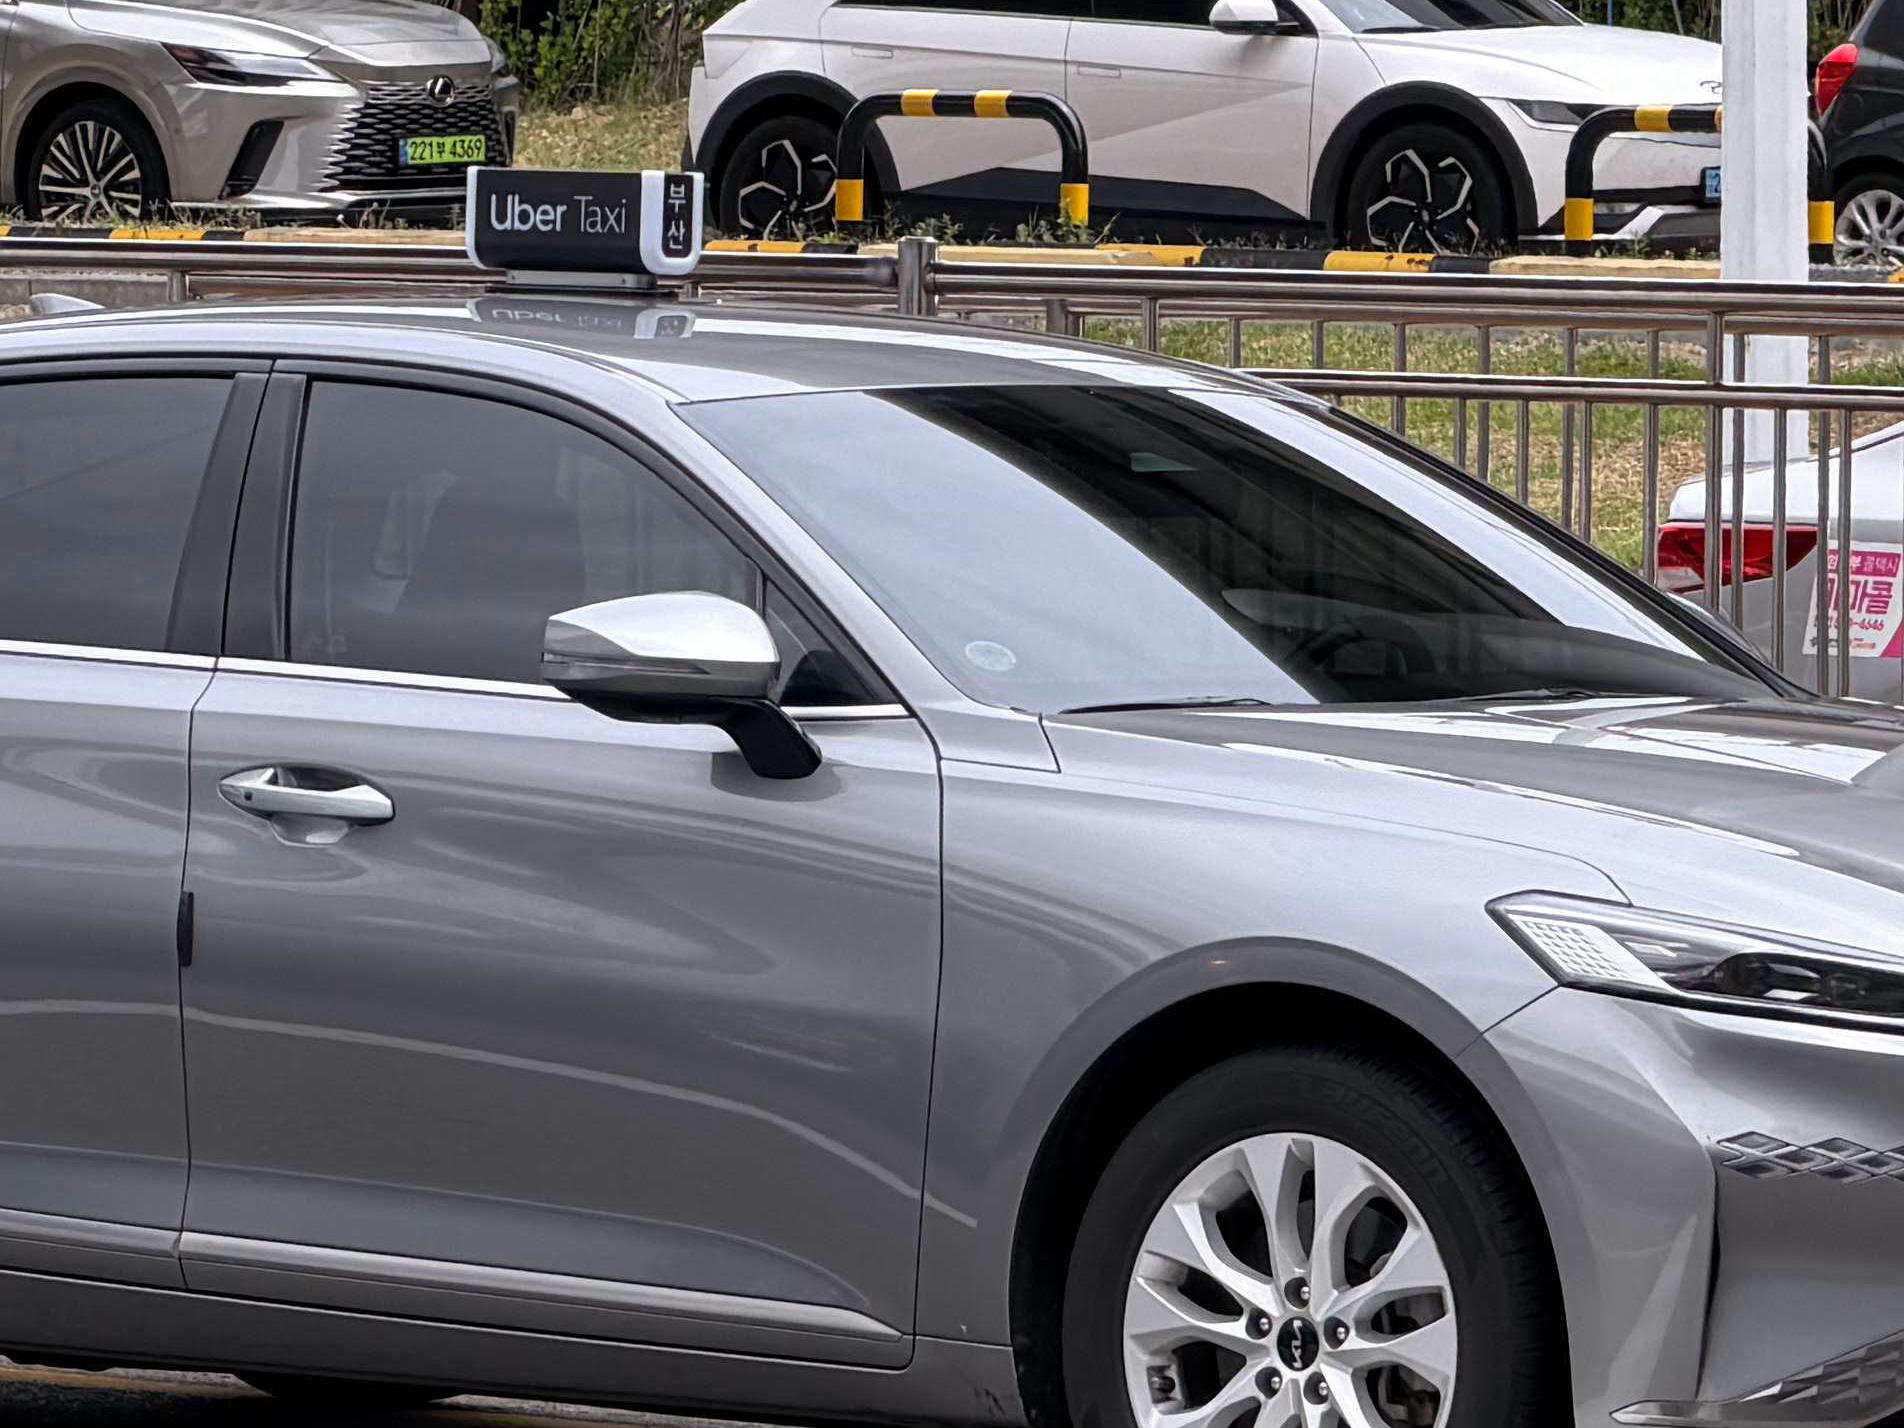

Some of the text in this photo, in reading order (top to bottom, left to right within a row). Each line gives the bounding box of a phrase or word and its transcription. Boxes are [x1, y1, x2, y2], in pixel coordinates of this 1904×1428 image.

[449, 138, 483, 159] 4369
[490, 193, 627, 234] Uber Taxi
[667, 182, 687, 251] 부산
